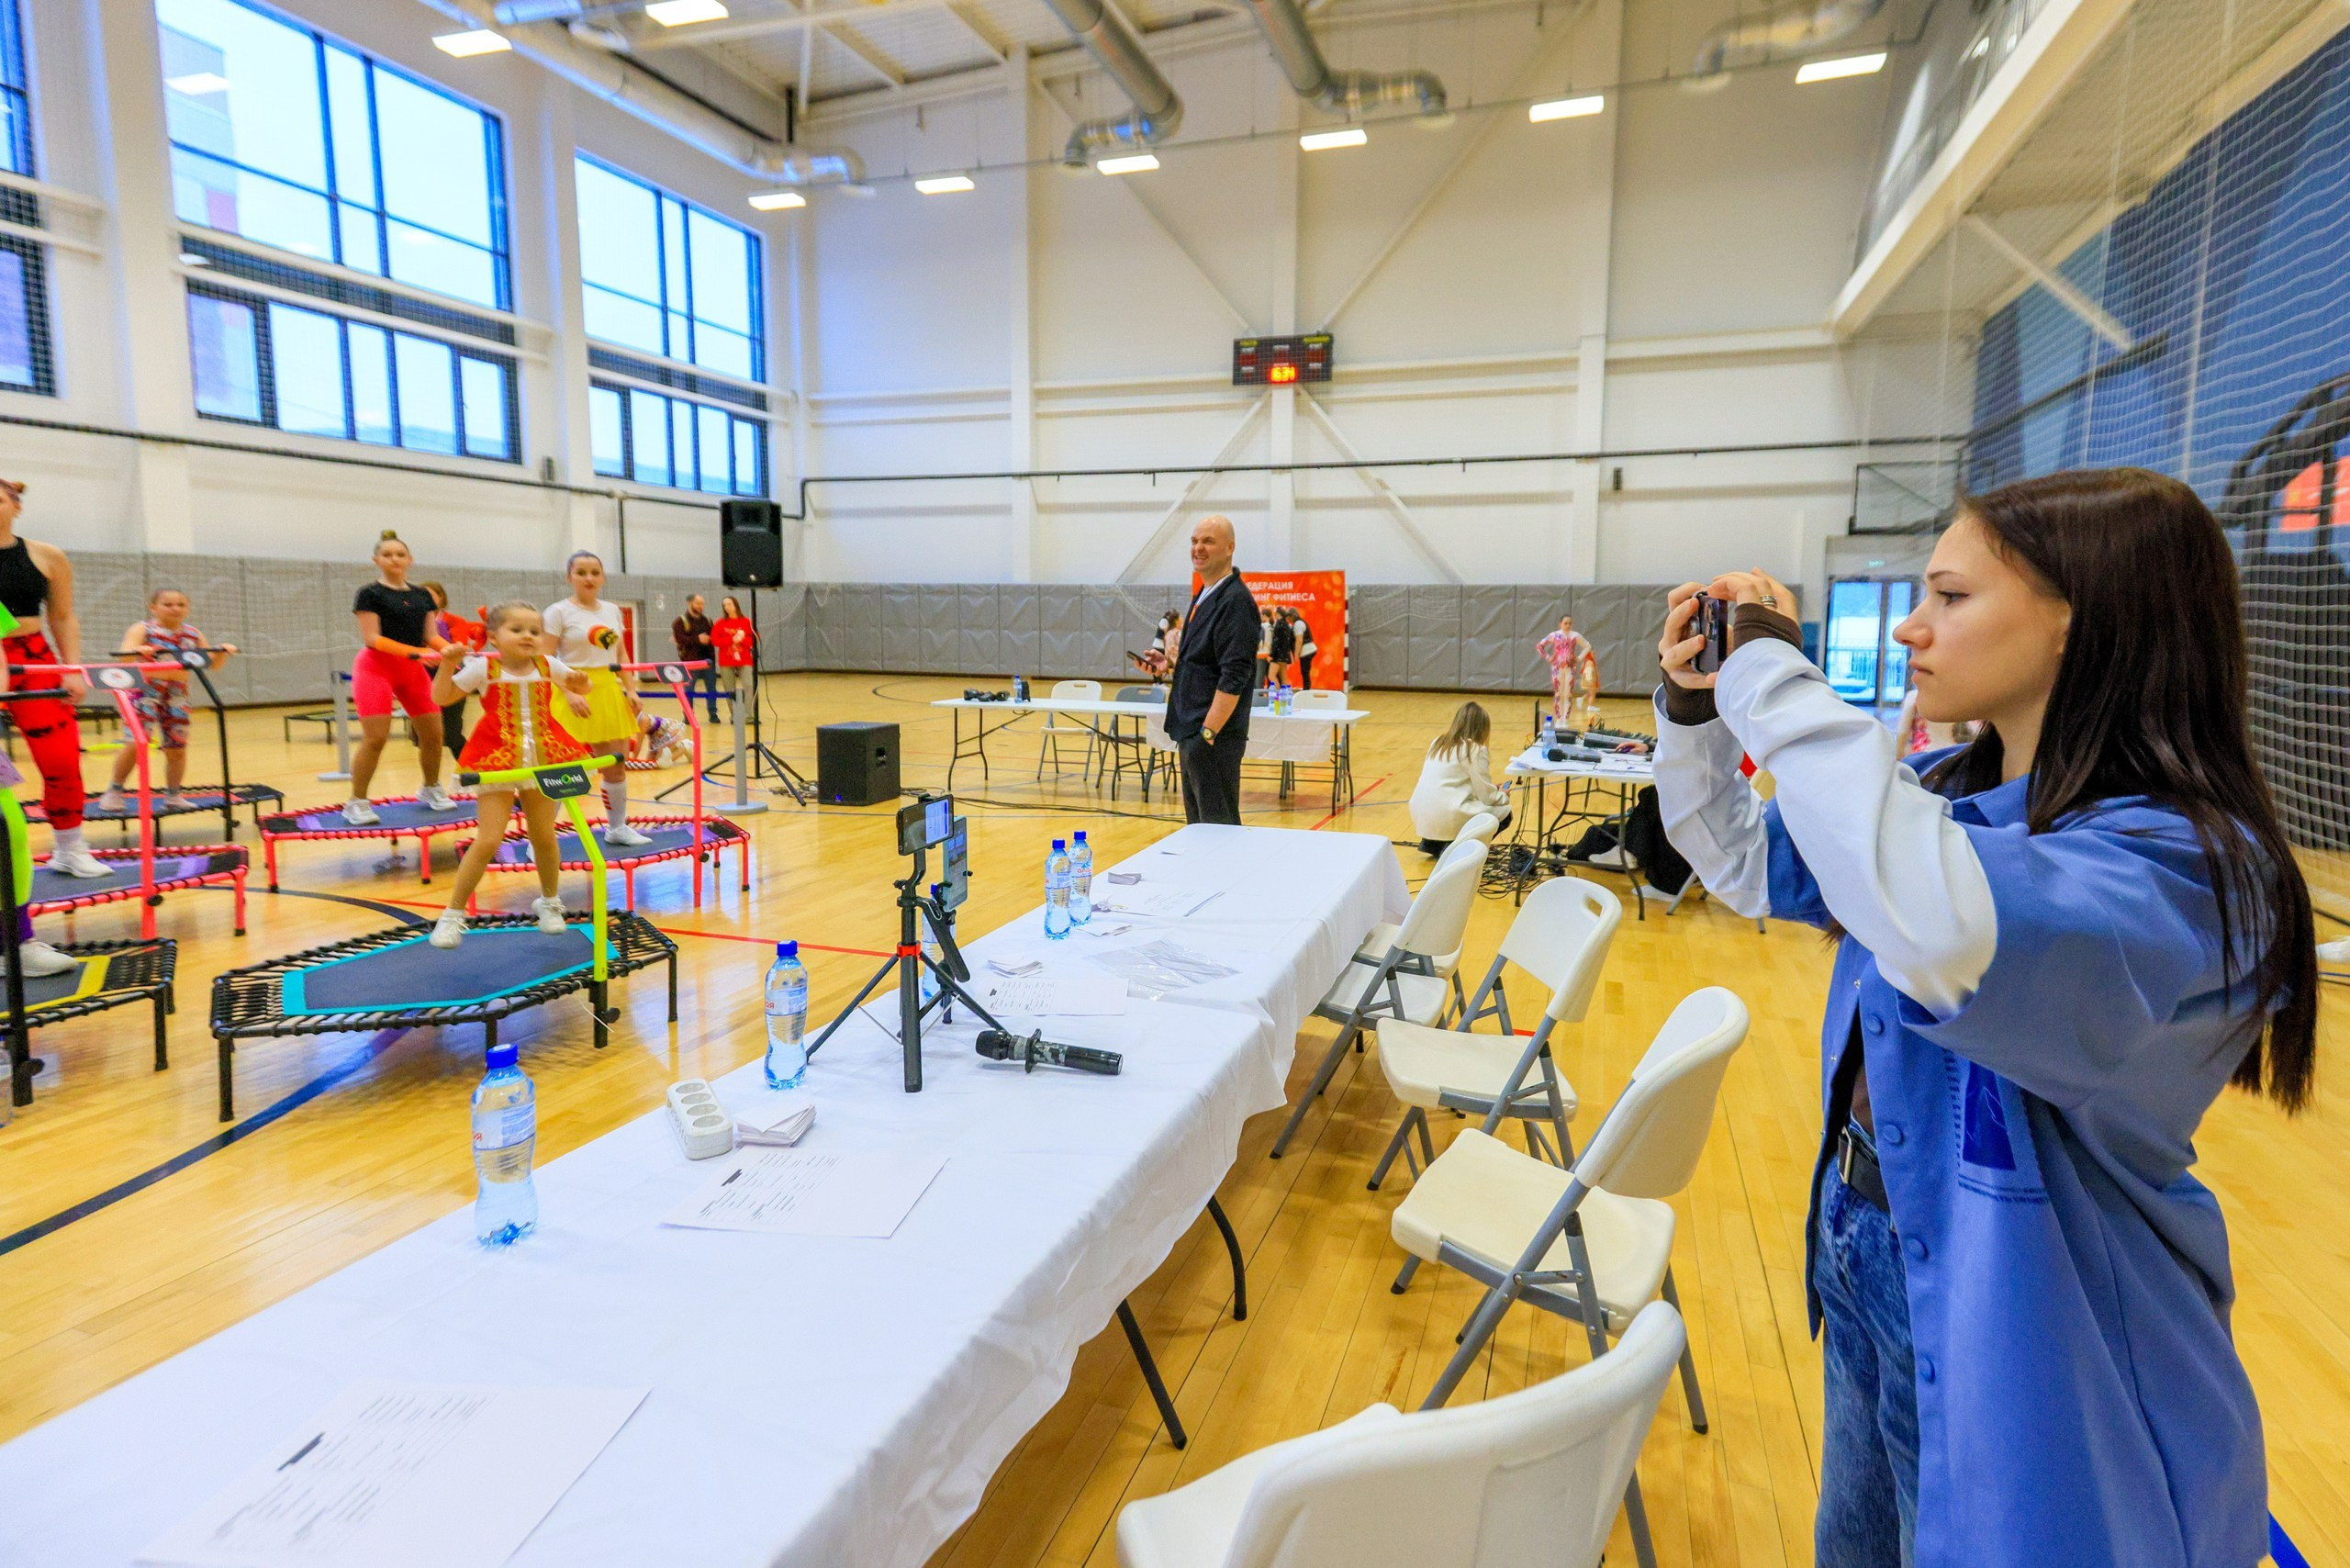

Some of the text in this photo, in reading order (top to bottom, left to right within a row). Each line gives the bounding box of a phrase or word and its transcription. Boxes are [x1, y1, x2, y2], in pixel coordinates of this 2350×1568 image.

[1245, 581, 1293, 591] ЕДЕРАЦИЯ
[1251, 592, 1315, 601] ИНГ ФИТНЕСА
